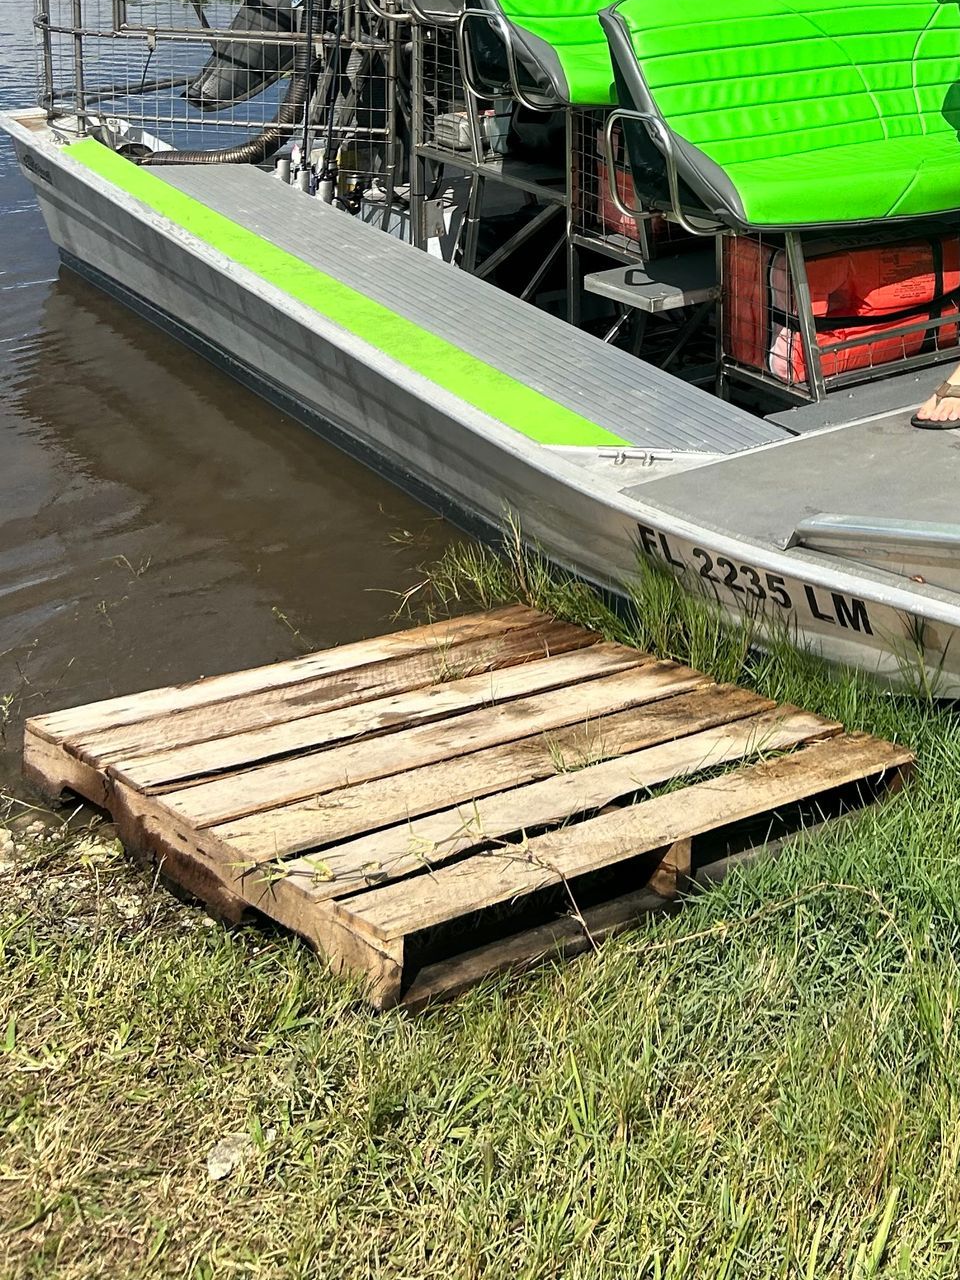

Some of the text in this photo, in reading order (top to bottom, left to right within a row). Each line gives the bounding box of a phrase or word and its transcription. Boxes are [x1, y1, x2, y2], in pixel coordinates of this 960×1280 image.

[636, 522, 874, 636] FL 2235 LM
